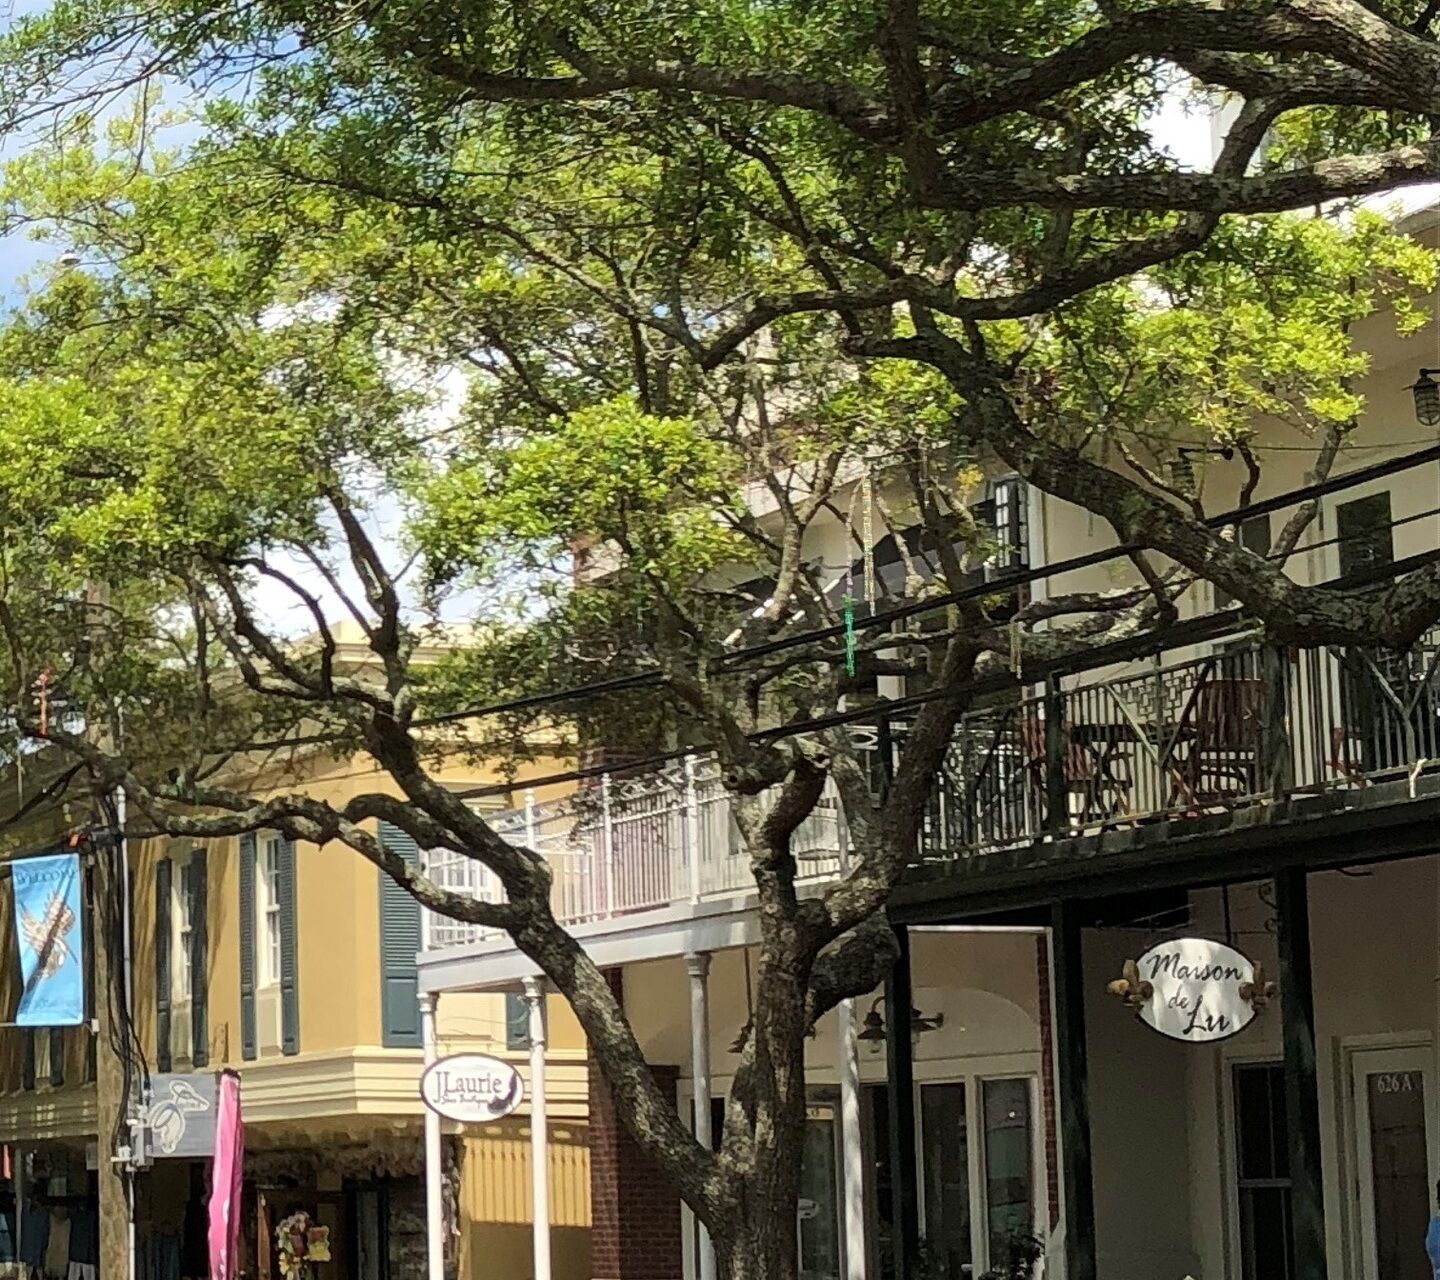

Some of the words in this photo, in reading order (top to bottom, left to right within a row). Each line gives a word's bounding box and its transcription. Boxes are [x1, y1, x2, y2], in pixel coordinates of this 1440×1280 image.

[1146, 952, 1243, 981] Maison
[1167, 982, 1189, 1009] de
[1182, 994, 1230, 1035] Lu
